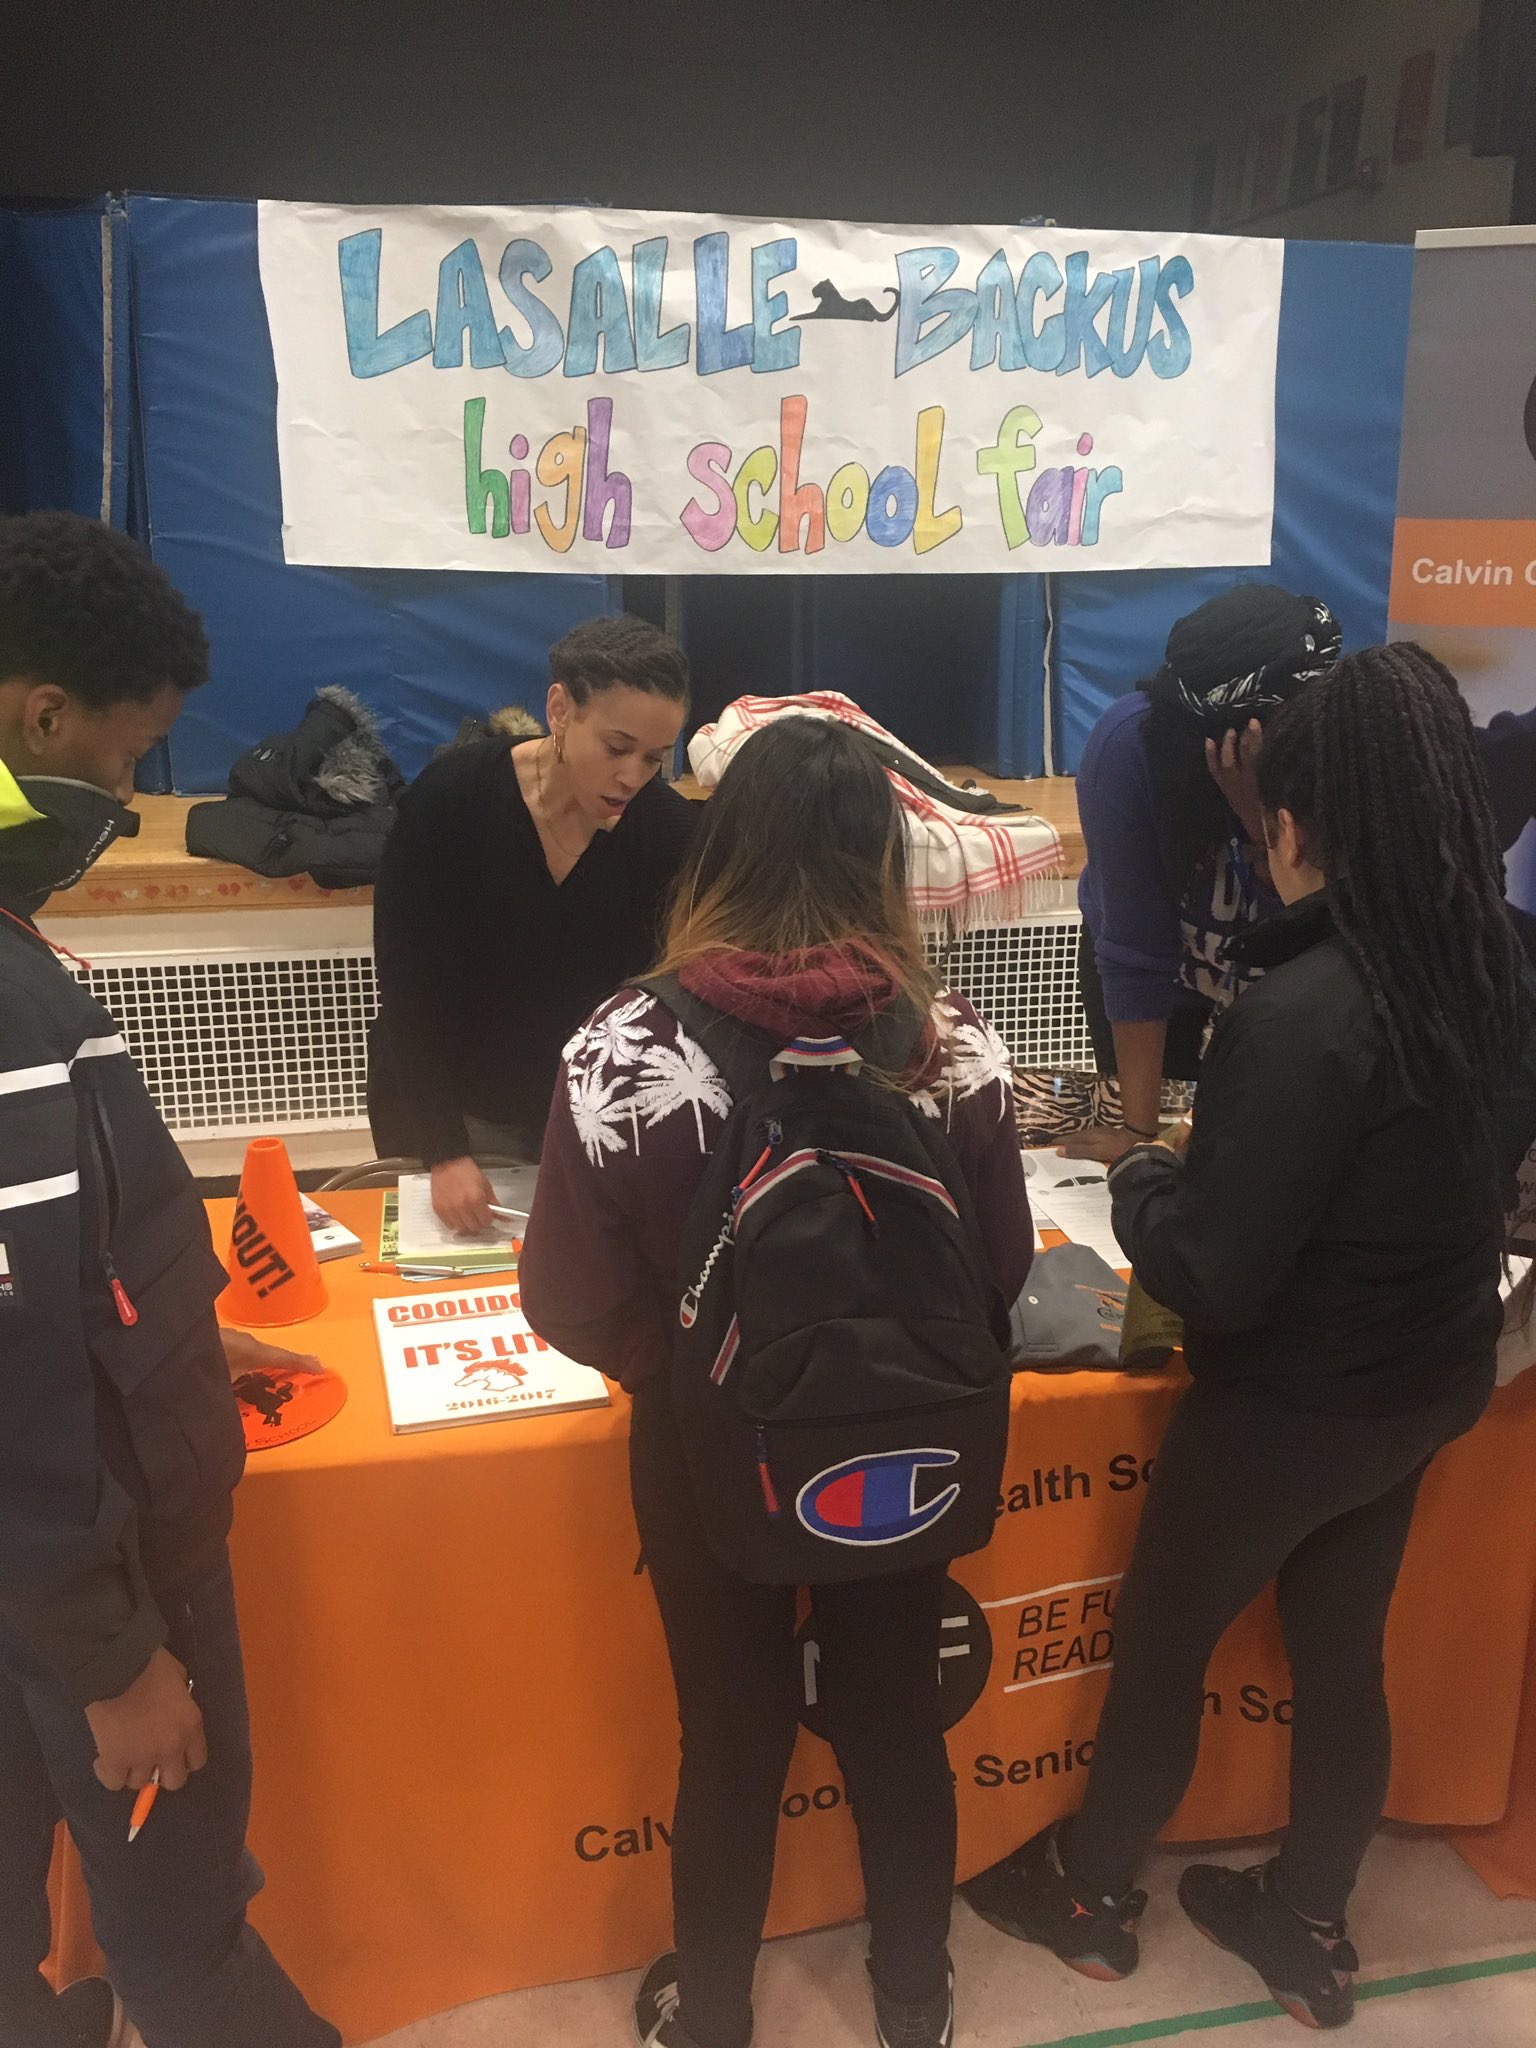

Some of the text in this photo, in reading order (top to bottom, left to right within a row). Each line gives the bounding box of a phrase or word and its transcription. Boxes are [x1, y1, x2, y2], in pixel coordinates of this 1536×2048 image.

[338, 228, 1194, 379] LASALLE BACKUS
[464, 397, 632, 554] high
[977, 405, 1123, 551] fair
[1412, 558, 1513, 586] Calvin
[403, 1339, 483, 1369] IT'S
[445, 1389, 557, 1411] 2016-2017
[1017, 1597, 1070, 1639] BE
[1012, 1630, 1115, 1681] READ
